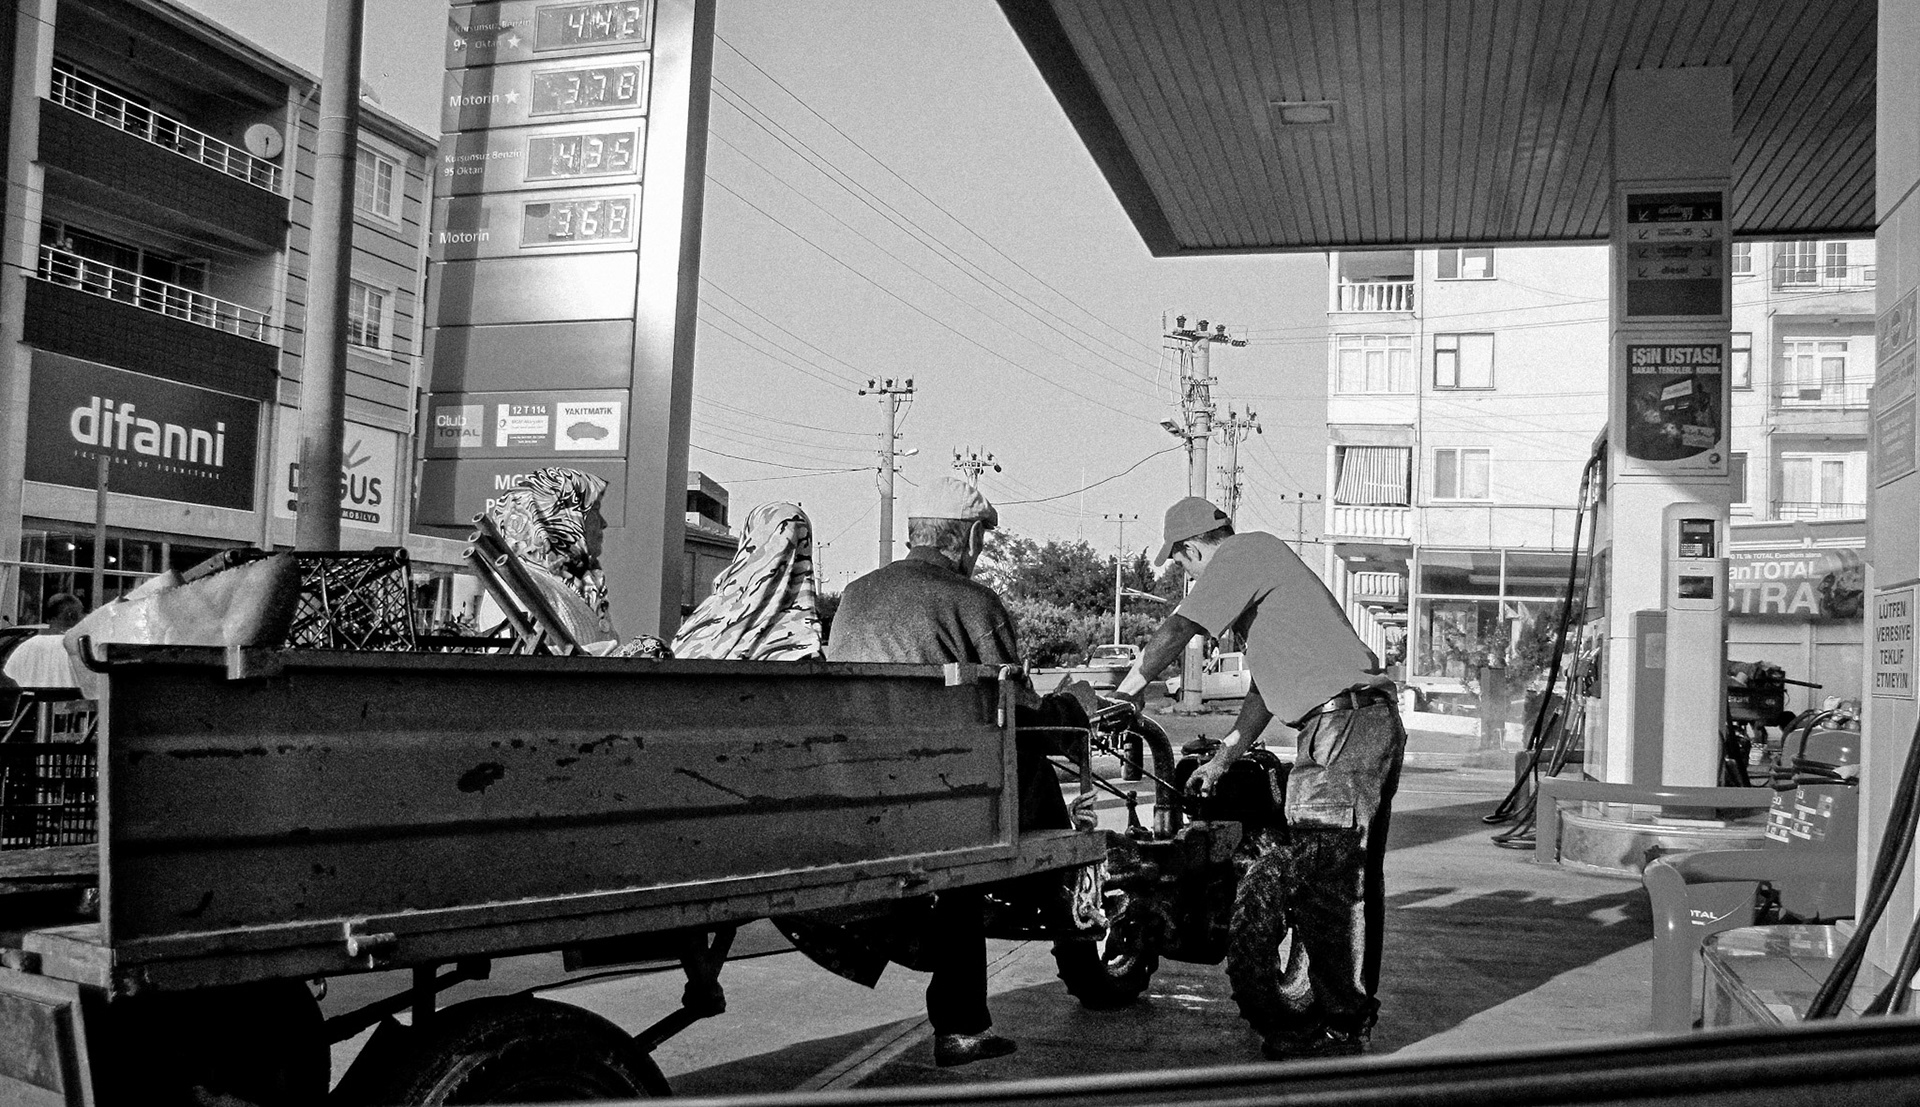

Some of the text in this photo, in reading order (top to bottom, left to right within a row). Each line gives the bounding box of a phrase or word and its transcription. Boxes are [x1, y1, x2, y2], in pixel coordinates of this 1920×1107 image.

[450, 92, 499, 107] Motorin
[492, 149, 522, 159] Benzin
[444, 166, 483, 177] 95 Oktan
[439, 231, 489, 244] Motorin
[1665, 347, 1721, 364] USTASI.
[512, 405, 546, 415] 12 T 114
[437, 415, 466, 427] Club
[70, 396, 225, 467] difanni
[438, 427, 480, 438] TOTAL
